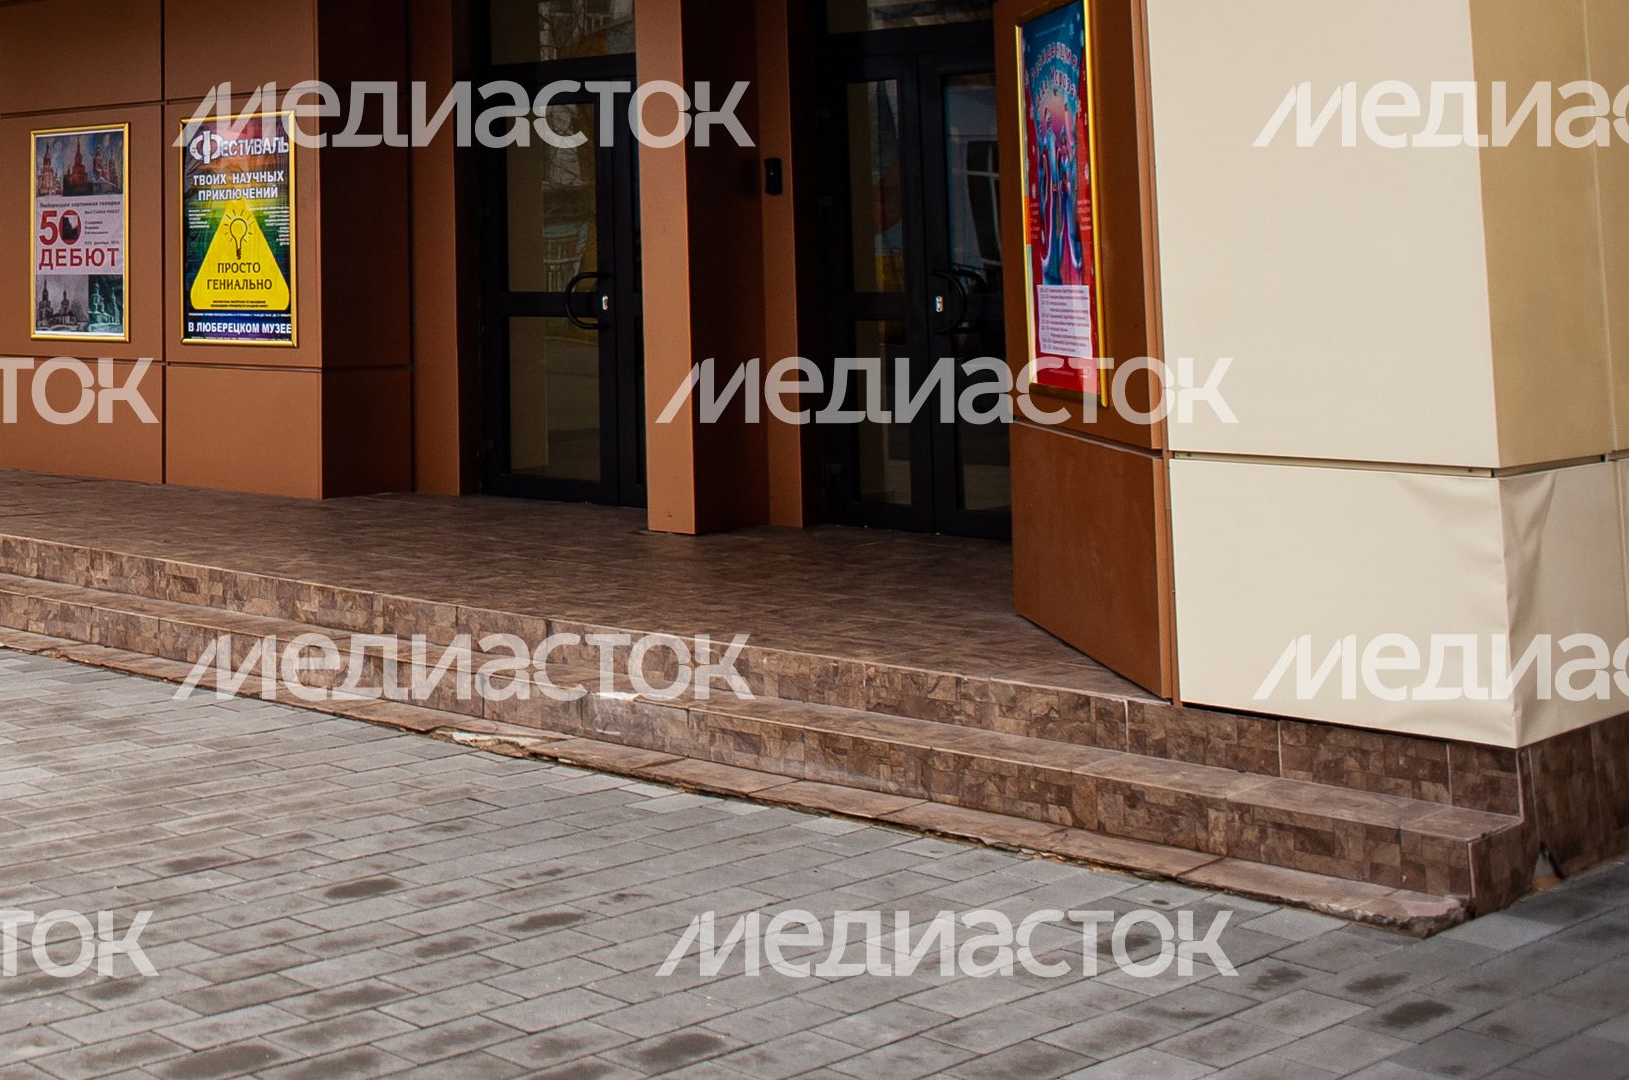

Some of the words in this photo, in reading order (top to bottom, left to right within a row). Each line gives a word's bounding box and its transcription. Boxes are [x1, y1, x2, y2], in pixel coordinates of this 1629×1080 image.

[189, 130, 289, 164] ФЕСТИВАЛЬ
[193, 174, 227, 186] ТВОИХ
[232, 170, 284, 184] НАУЧНЫХ
[198, 185, 278, 201] ПРИКЛЮЧЕНИЙ
[39, 210, 82, 246] 50
[39, 248, 120, 271] ДЕБЮТ
[217, 262, 261, 273] ПРОСТО
[207, 278, 273, 290] ГЕНИАЛЬНО
[188, 322, 195, 332] В
[196, 322, 260, 334] ЛЮБЕРЕЦКОМ
[261, 323, 292, 334] МУЗЕЕ
